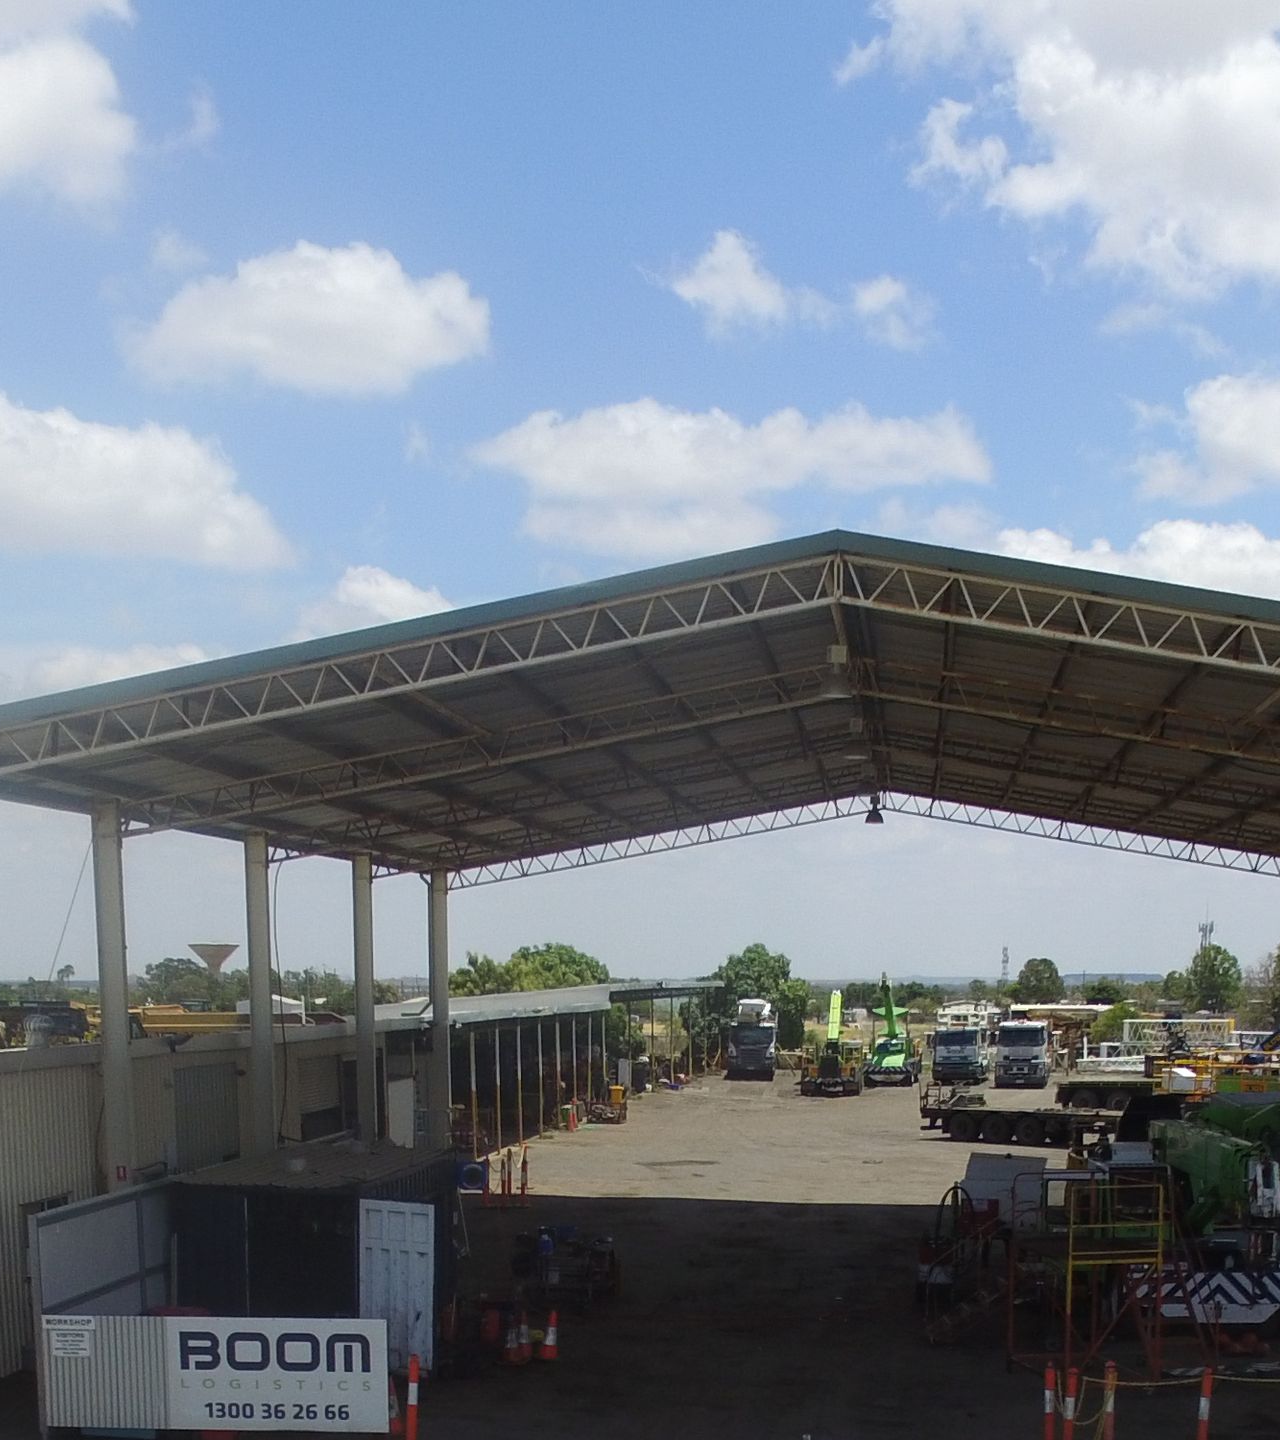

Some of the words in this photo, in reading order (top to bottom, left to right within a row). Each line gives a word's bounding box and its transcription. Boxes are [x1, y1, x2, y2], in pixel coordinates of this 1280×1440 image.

[45, 1318, 92, 1326] WORKSHOP
[179, 1331, 371, 1373] BOOM
[180, 1378, 371, 1391] LOGISTICS
[204, 1402, 254, 1419] 1300
[261, 1403, 286, 1420] 36
[292, 1404, 318, 1420] 26
[324, 1404, 350, 1420] 66
